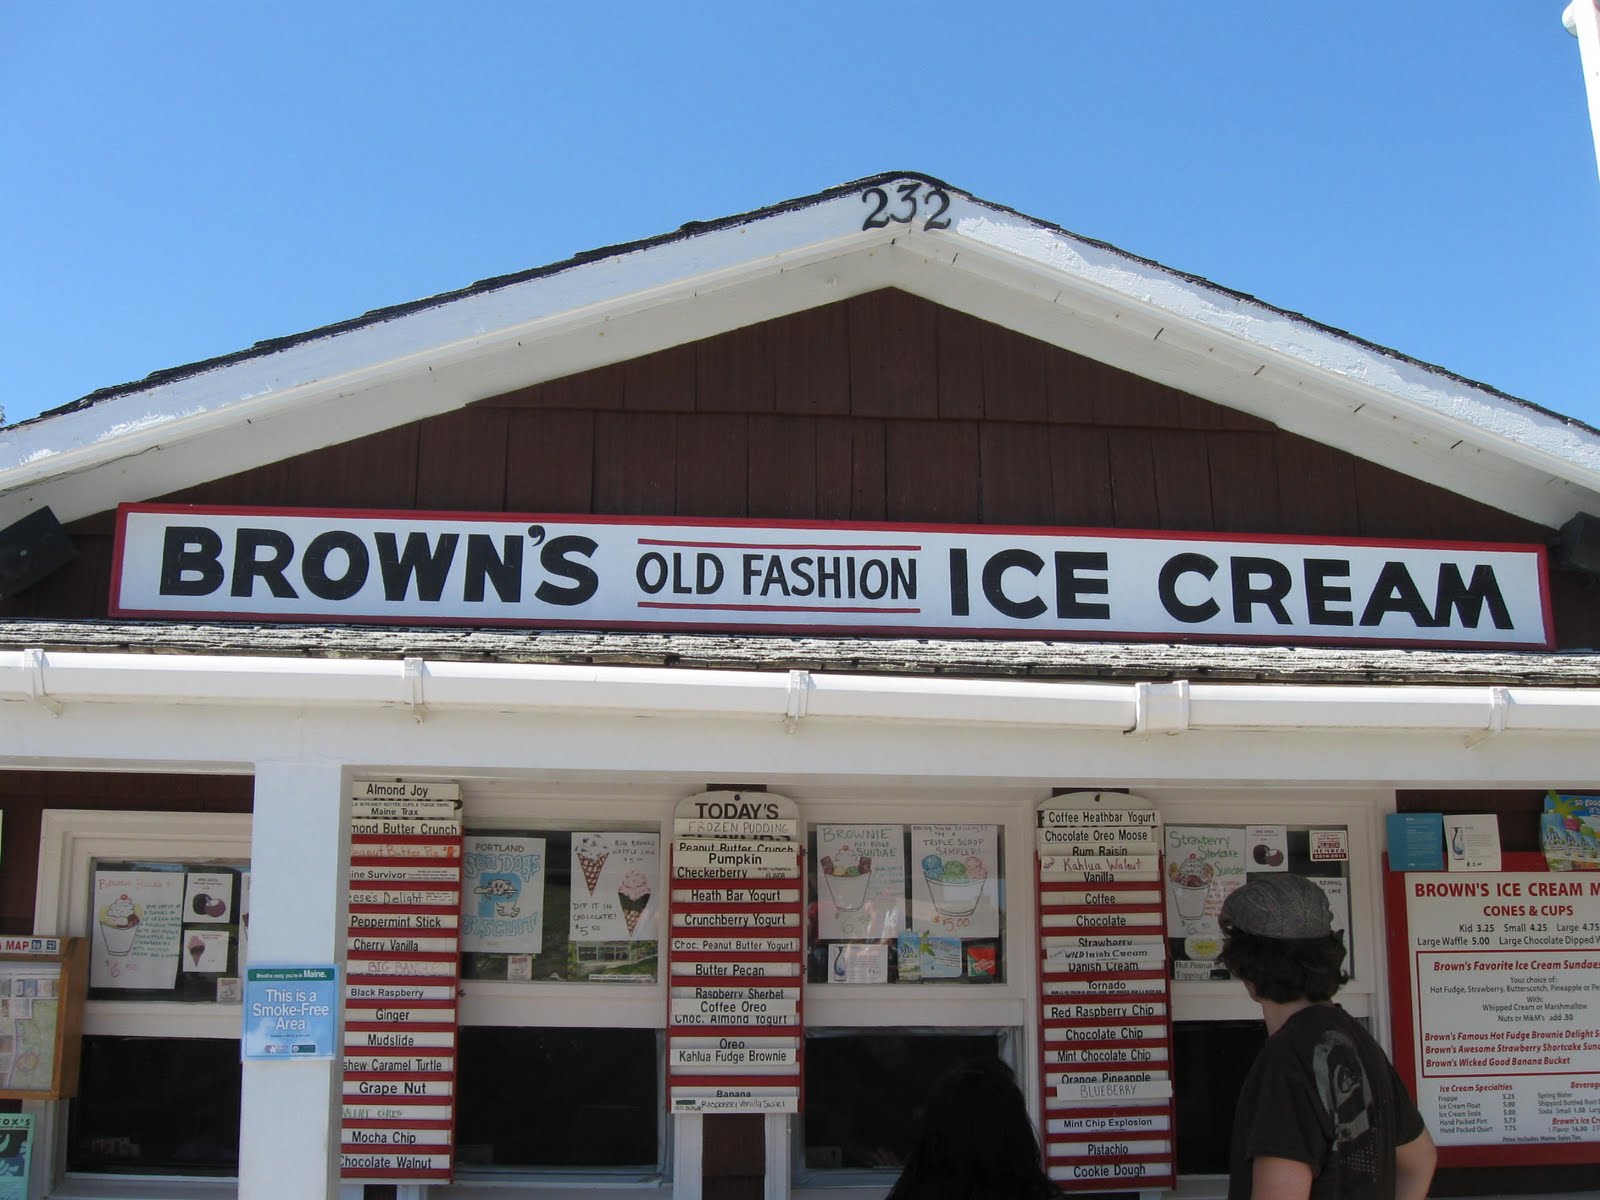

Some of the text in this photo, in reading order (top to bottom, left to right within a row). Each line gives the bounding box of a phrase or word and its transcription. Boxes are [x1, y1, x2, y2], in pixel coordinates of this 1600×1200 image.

[862, 183, 951, 231] 232
[159, 524, 1514, 630] BROWN'S OLD FASHION ICE CREAM
[366, 783, 428, 798] Almond Joy
[371, 808, 419, 816] Maine Trax
[695, 803, 779, 819] TODAY'S
[1048, 812, 1156, 825] Coffee Heathbar Yogurt
[351, 824, 457, 835] mond Butter Crunch
[822, 827, 893, 842] BROWNIE
[1045, 830, 1148, 842] Chocolate Oreo Moose
[475, 843, 525, 853] PORTLAND
[680, 843, 793, 852] Peanut Butter Crunch
[1072, 846, 1128, 856] Rum Raisin
[709, 853, 762, 866] Pumpkin
[367, 870, 407, 879] Survivor
[677, 867, 747, 879] Checkerberry
[1084, 872, 1114, 882] Vanilla
[1415, 882, 1583, 897] BROWN'S ICE CREAM
[691, 890, 780, 902] Heath Bar Yogurt
[1085, 893, 1116, 905] Coffee
[1483, 905, 1573, 917] CONES & CUPS
[351, 915, 441, 928] Peppermint Stick
[685, 914, 786, 927] Crunchberry Yogurt
[1076, 915, 1127, 927] Chocolate
[1459, 923, 1579, 933] Kid 3.25 Small 4.25 Large
[6, 941, 29, 950] MAP
[353, 939, 419, 951] Cherry Vanilla
[703, 941, 793, 951] Peanut Butter Yogurt
[1078, 938, 1133, 947] Strawberry
[1417, 935, 1594, 948] Large Waffle 5.00 Large Chocolate Dipped
[696, 964, 764, 976] Butter Pecan
[1434, 960, 1561, 971] Brown's Favorite Ice Cream
[1087, 981, 1126, 990] Tornado
[1510, 976, 1547, 984] Your choice
[265, 989, 316, 1002] This is a
[351, 988, 424, 999] Black Raspberry
[696, 988, 784, 999] Raspberry Sherbet
[1430, 986, 1443, 994] Hot
[252, 1002, 329, 1017] Smoke-Free
[701, 1000, 767, 1013] Coffee Oreo
[1051, 1004, 1154, 1018] Red Raspberry Chip
[1482, 1004, 1513, 1013] Whipped
[1514, 1003, 1535, 1011] Cream
[376, 1008, 410, 1022] Ginger
[710, 1015, 787, 1026] Almond Yogurt
[276, 1017, 305, 1030] Area
[1065, 1027, 1144, 1040] Chocolate Chip
[1425, 1029, 1594, 1041] Brown's Famous Hot Fudge Brownie Delight
[367, 1034, 414, 1046] Mudslide
[719, 1038, 745, 1049] Oreo
[1425, 1043, 1582, 1054] Brown's Awesome Strawberry Shortcake
[679, 1050, 787, 1064] Kahlua Fudge Brownie
[1058, 1049, 1151, 1062] Mint Chocolate Chip
[343, 1059, 442, 1071] shew Caramel Turtle
[1426, 1056, 1570, 1068] Brown's Wicked Good Banana Bucket
[359, 1082, 426, 1095] Grape Nut
[1439, 1083, 1513, 1093] Ice Cream Specialties
[1063, 1118, 1152, 1129] Mint Chip Explosion
[352, 1131, 416, 1144] Mocha Chip
[1088, 1143, 1128, 1155] Pistachio
[340, 1155, 432, 1169] Chocolate Walnut
[1074, 1164, 1145, 1178] Cookie Dough
